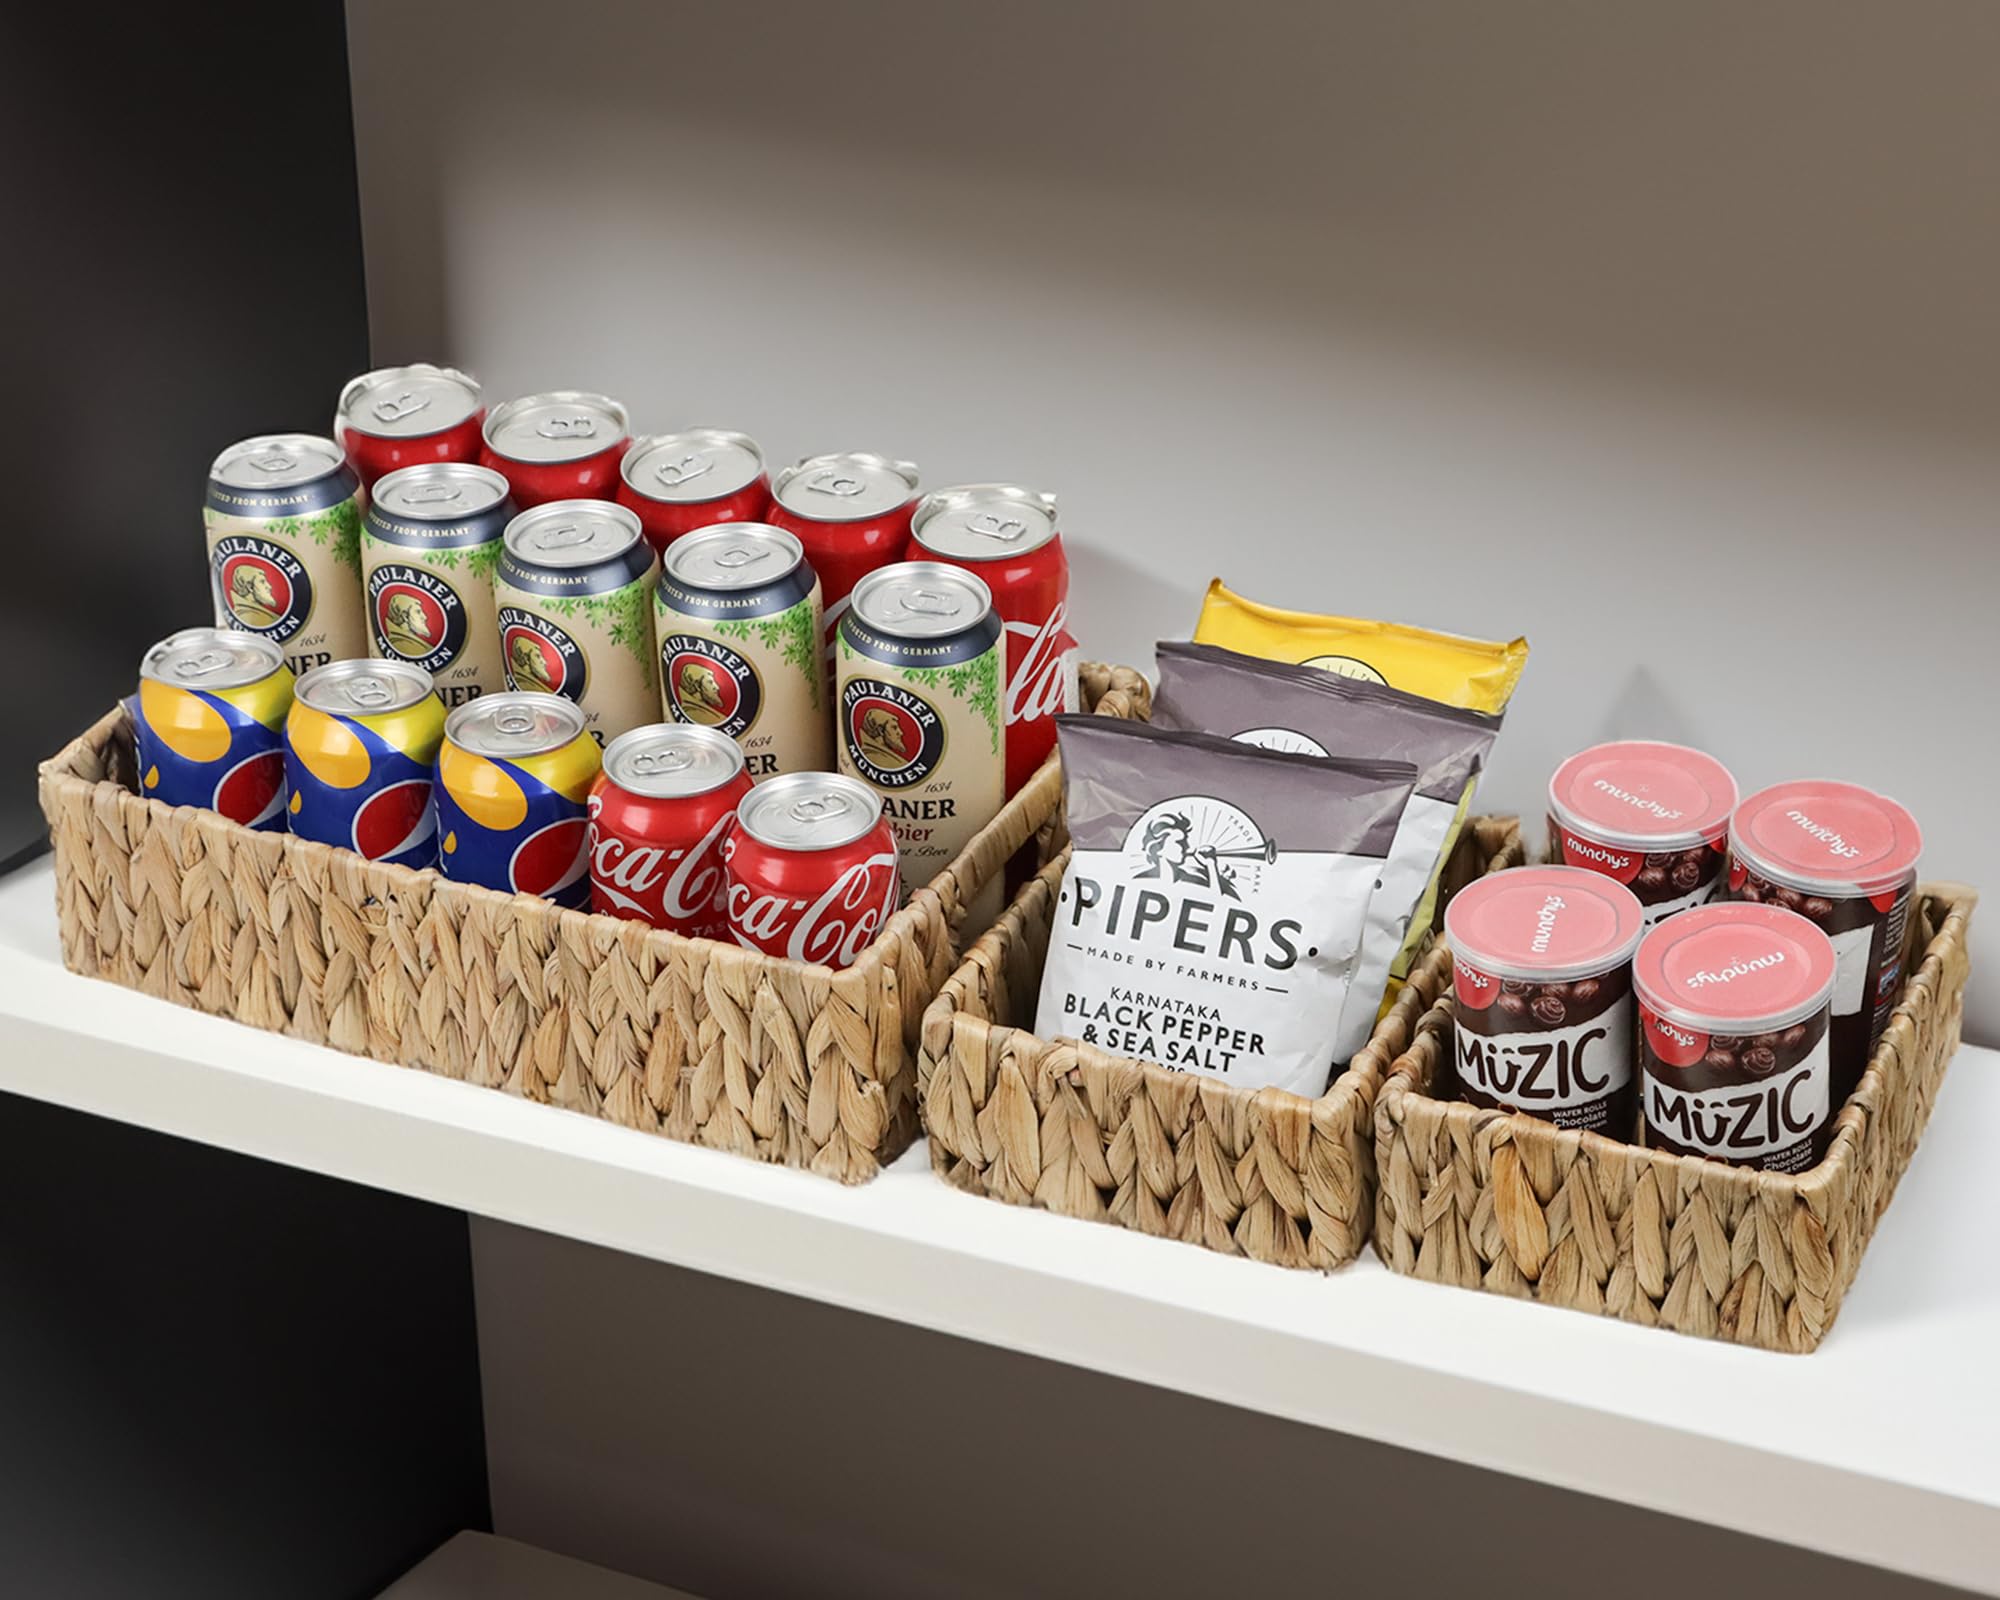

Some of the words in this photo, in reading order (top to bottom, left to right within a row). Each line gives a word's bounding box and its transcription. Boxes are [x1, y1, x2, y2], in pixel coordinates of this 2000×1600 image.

[232, 496, 257, 506] FROM
[260, 495, 308, 507] GERMANY
[393, 524, 418, 537] FROM
[421, 526, 470, 538] GERMANY
[515, 567, 537, 582] FROM
[540, 575, 588, 586] GERMANY
[684, 594, 710, 608] FROM
[713, 597, 762, 609] GERMANY
[873, 639, 899, 655] FROM
[902, 645, 952, 657] GERMANY
[843, 681, 936, 729] PAULANER
[744, 735, 773, 750] 1634
[924, 780, 952, 794] 1634
[1228, 815, 1254, 842] TRADE
[1567, 837, 1630, 870] munchy's
[1071, 876, 1303, 971] PIPERS
[1086, 946, 1134, 965] MADE
[1145, 958, 1166, 971] BY
[1176, 965, 1260, 991] FARMERS
[1686, 951, 1785, 988] munchy's
[1110, 986, 1222, 1022] KARNATAKA
[1063, 993, 1153, 1032] BLACK
[1161, 1015, 1266, 1056] PEPPER
[1082, 1024, 1100, 1045] &
[1106, 1029, 1157, 1058] SEA
[1165, 1041, 1237, 1073] SALT
[1552, 1109, 1582, 1118] WAFER
[1583, 1101, 1608, 1113] ROLLS
[1552, 1110, 1608, 1127] Chocolate
